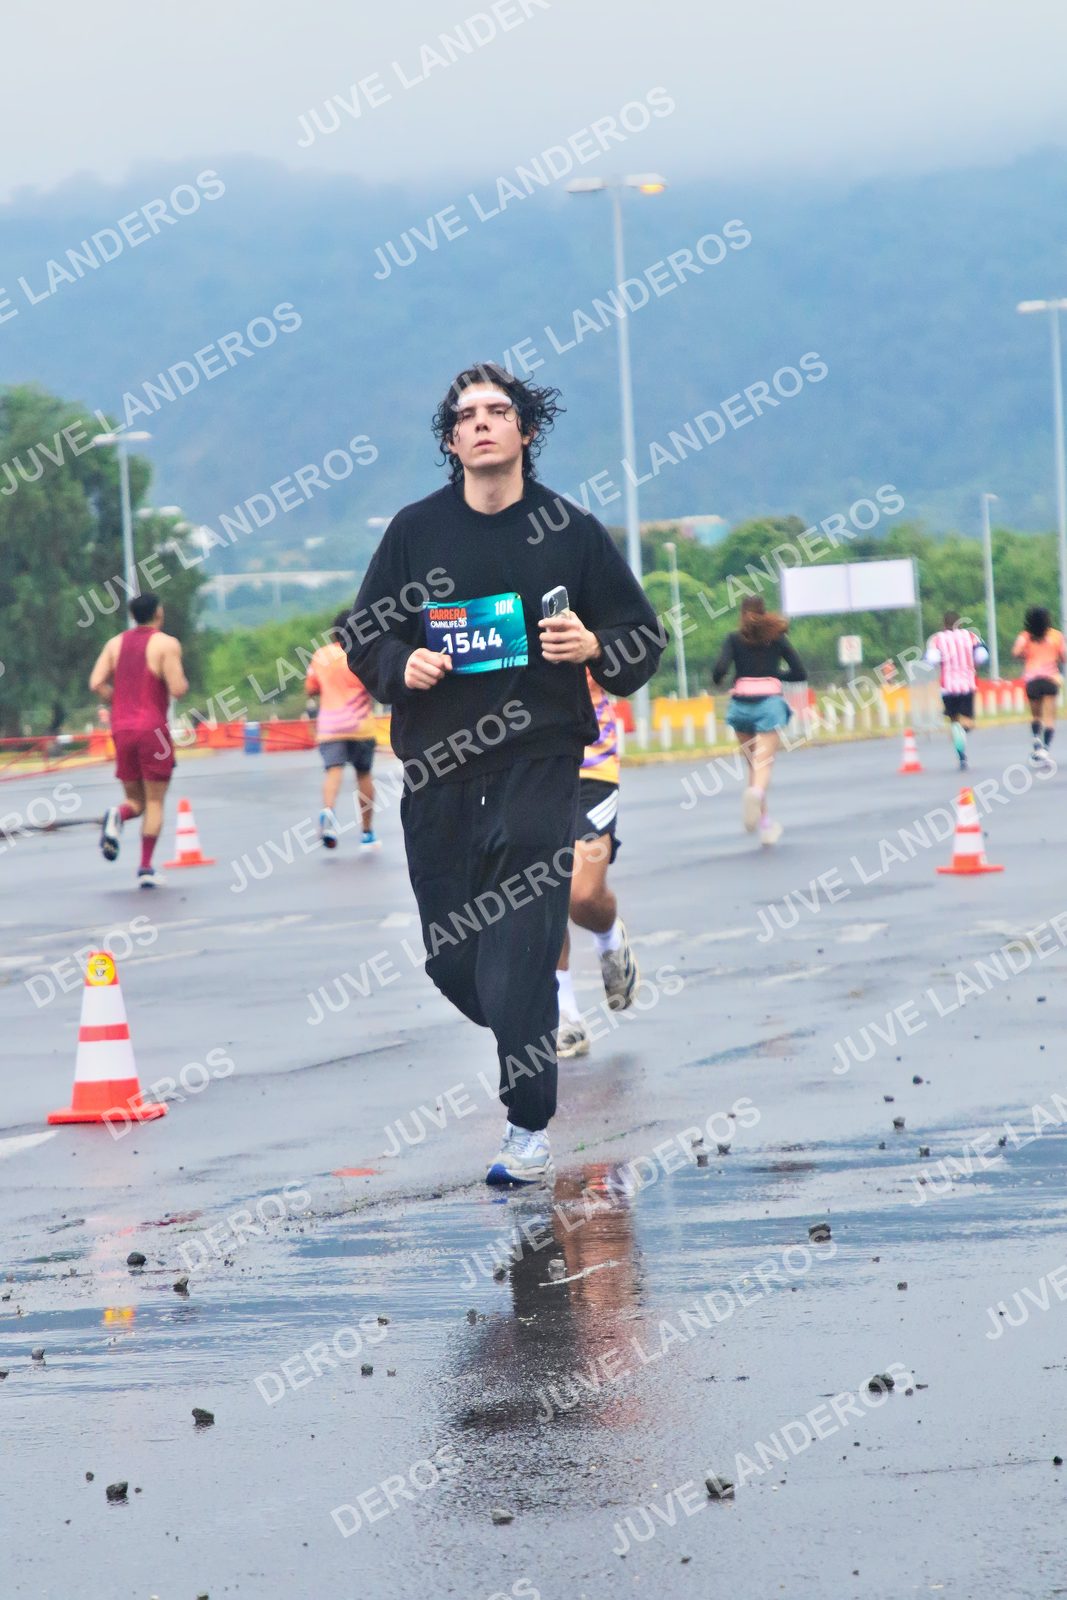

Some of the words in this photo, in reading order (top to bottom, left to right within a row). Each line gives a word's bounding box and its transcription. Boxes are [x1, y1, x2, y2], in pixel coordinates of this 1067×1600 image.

[430, 608, 466, 620] CARRERA
[495, 599, 514, 616] 10K
[442, 628, 503, 654] 1544
